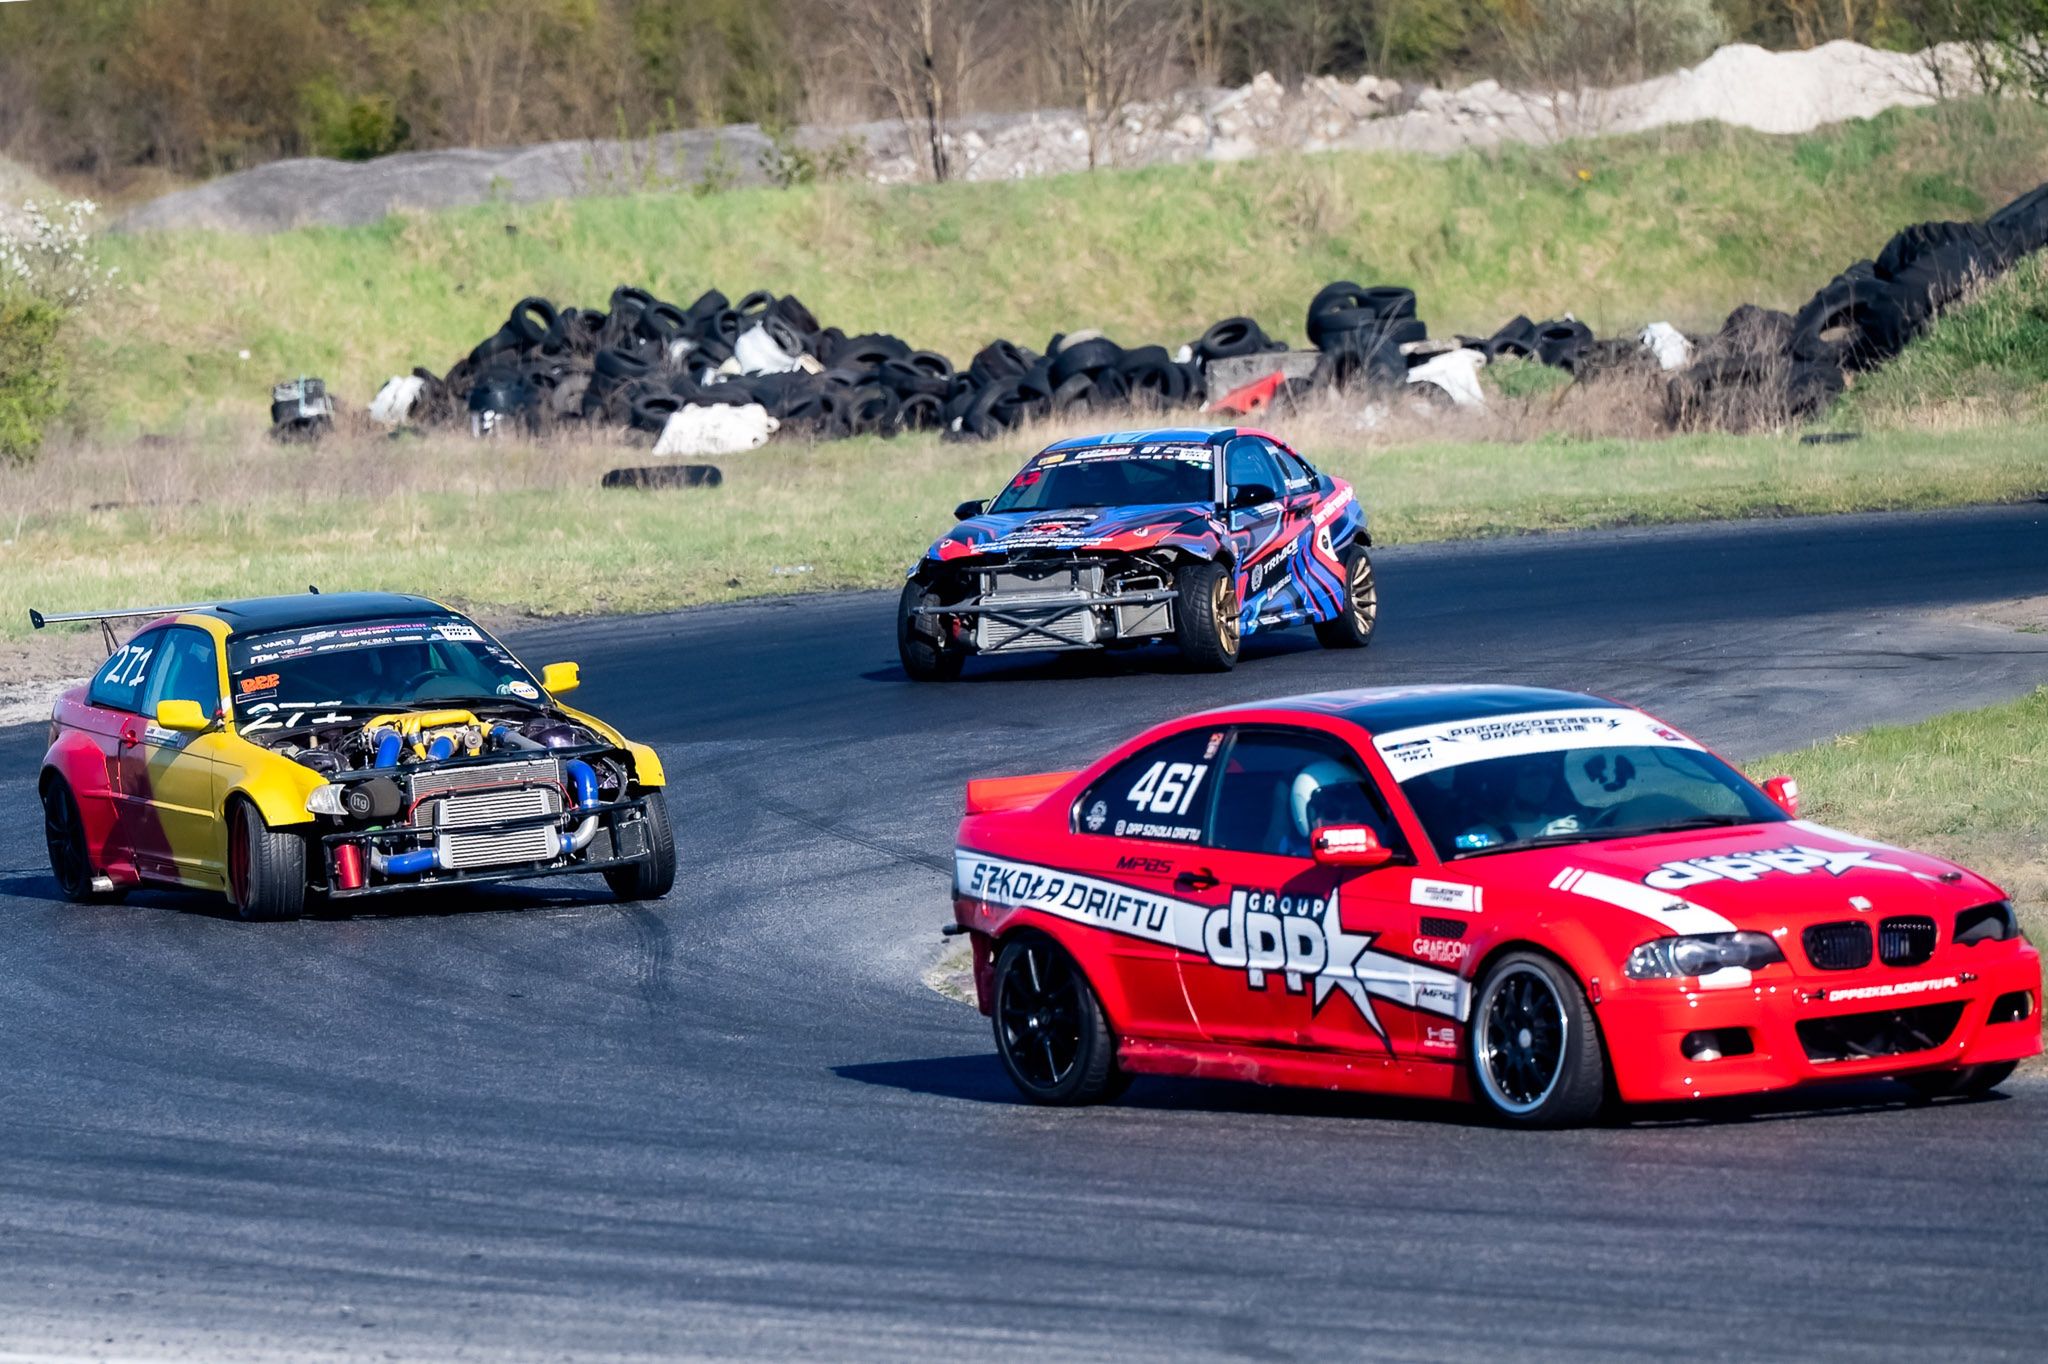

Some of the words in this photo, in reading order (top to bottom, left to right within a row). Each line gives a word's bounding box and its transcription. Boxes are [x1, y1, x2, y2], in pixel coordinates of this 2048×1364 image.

[262, 638, 295, 649] VARTA
[104, 645, 153, 687] 271
[1127, 761, 1208, 815] 461
[971, 862, 1065, 903] SZKOŁA
[1060, 881, 1168, 932] DRIFTU
[1248, 893, 1324, 917] GROUP
[1204, 890, 1326, 991] dpp
[1413, 938, 1471, 958] GRAFICON
